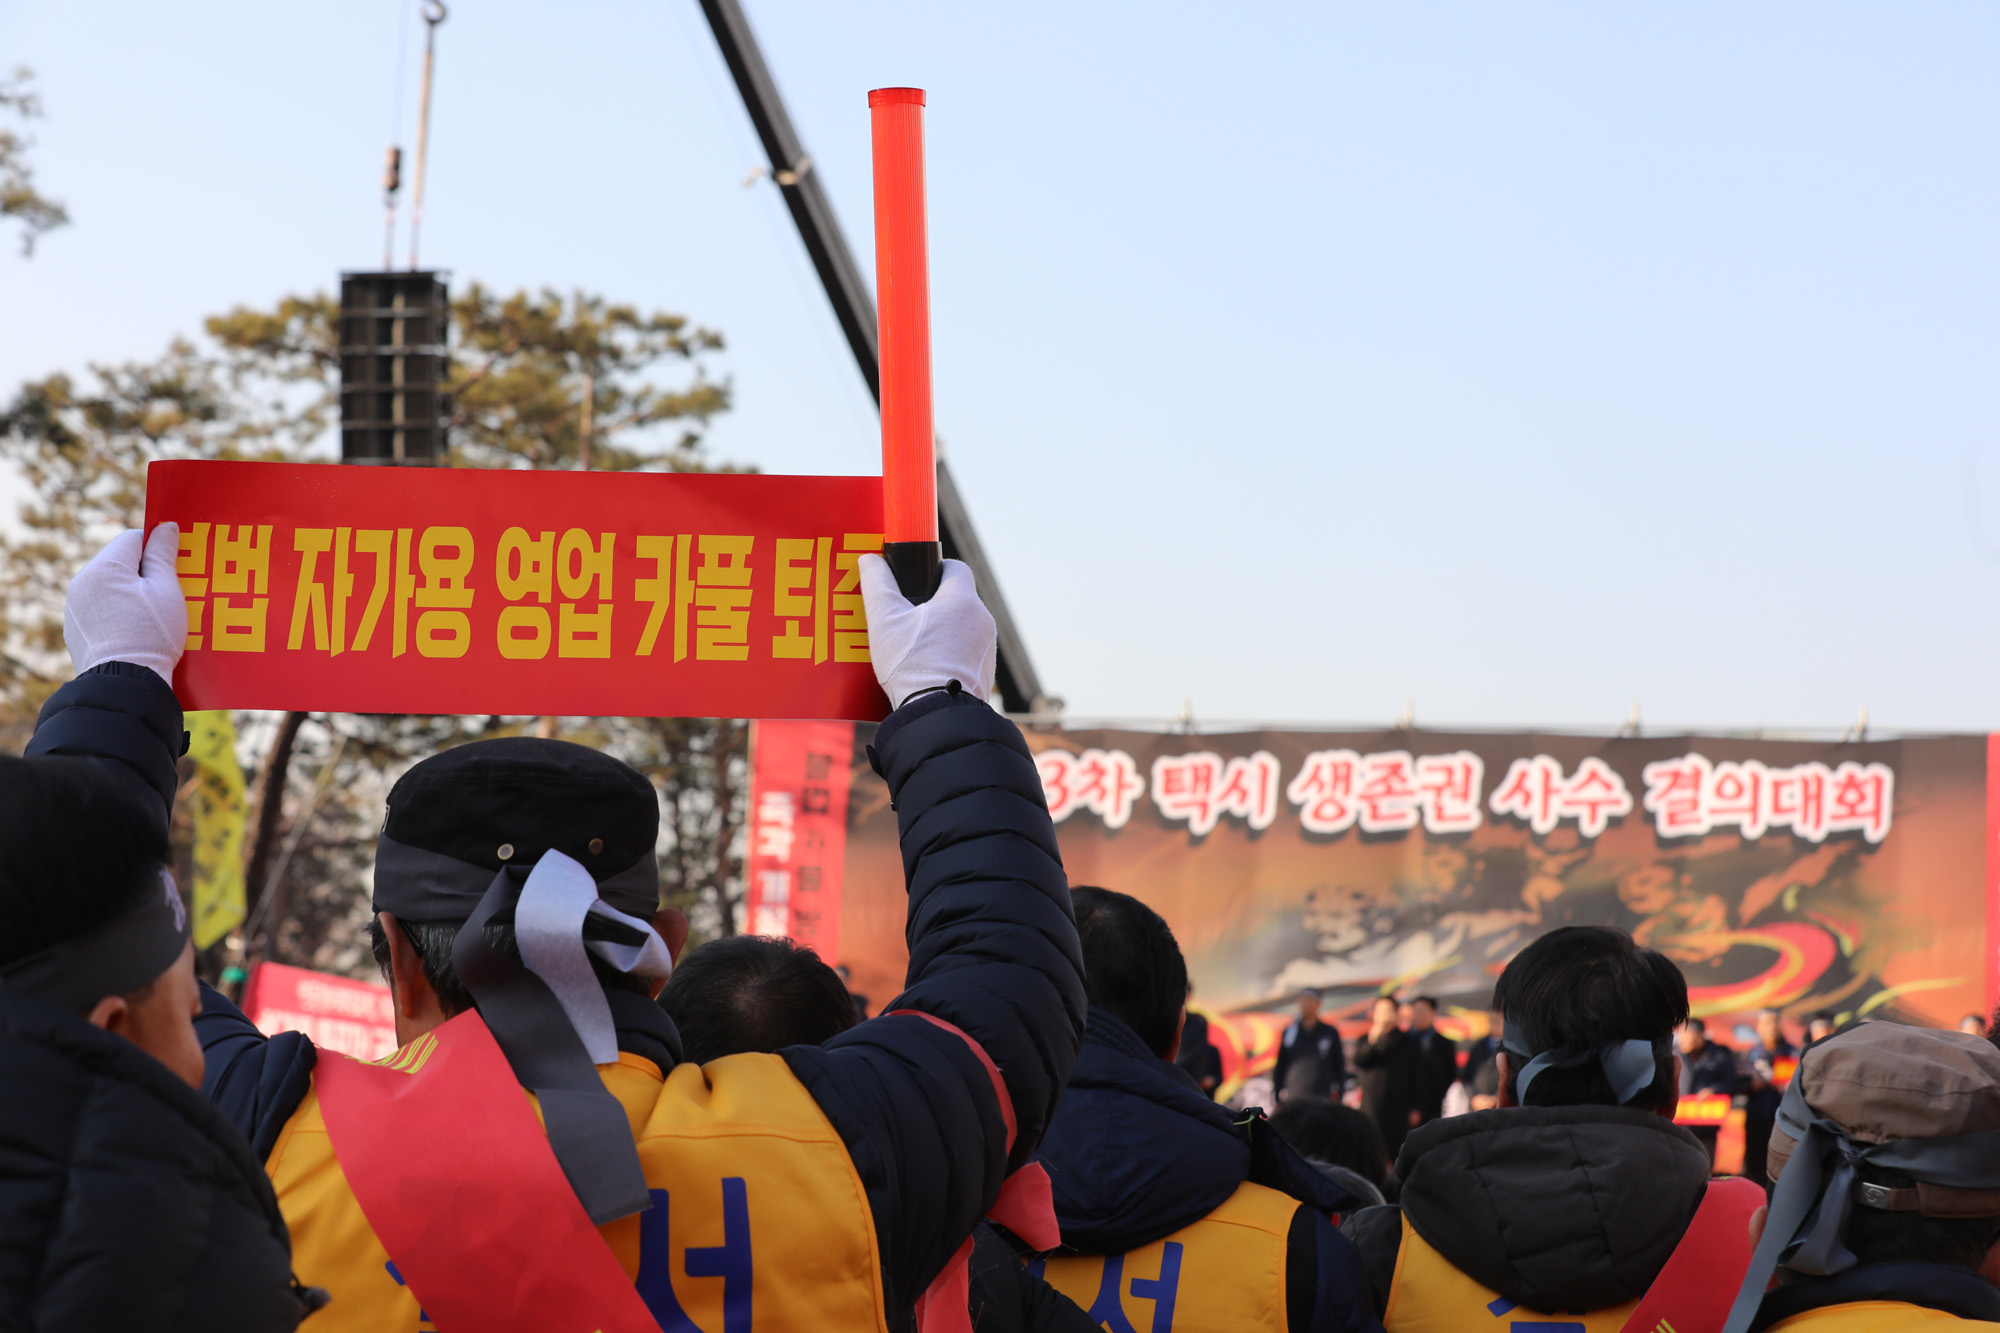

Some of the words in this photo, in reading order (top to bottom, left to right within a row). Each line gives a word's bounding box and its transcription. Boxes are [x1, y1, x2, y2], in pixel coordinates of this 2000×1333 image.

[286, 526, 475, 659] 자가용
[495, 526, 617, 661] 영업
[634, 534, 756, 664] 카풀
[1152, 751, 1281, 836] 택시
[1287, 749, 1484, 834] 생존권
[1490, 754, 1633, 838] 사수
[1643, 753, 1894, 843] 결의대회
